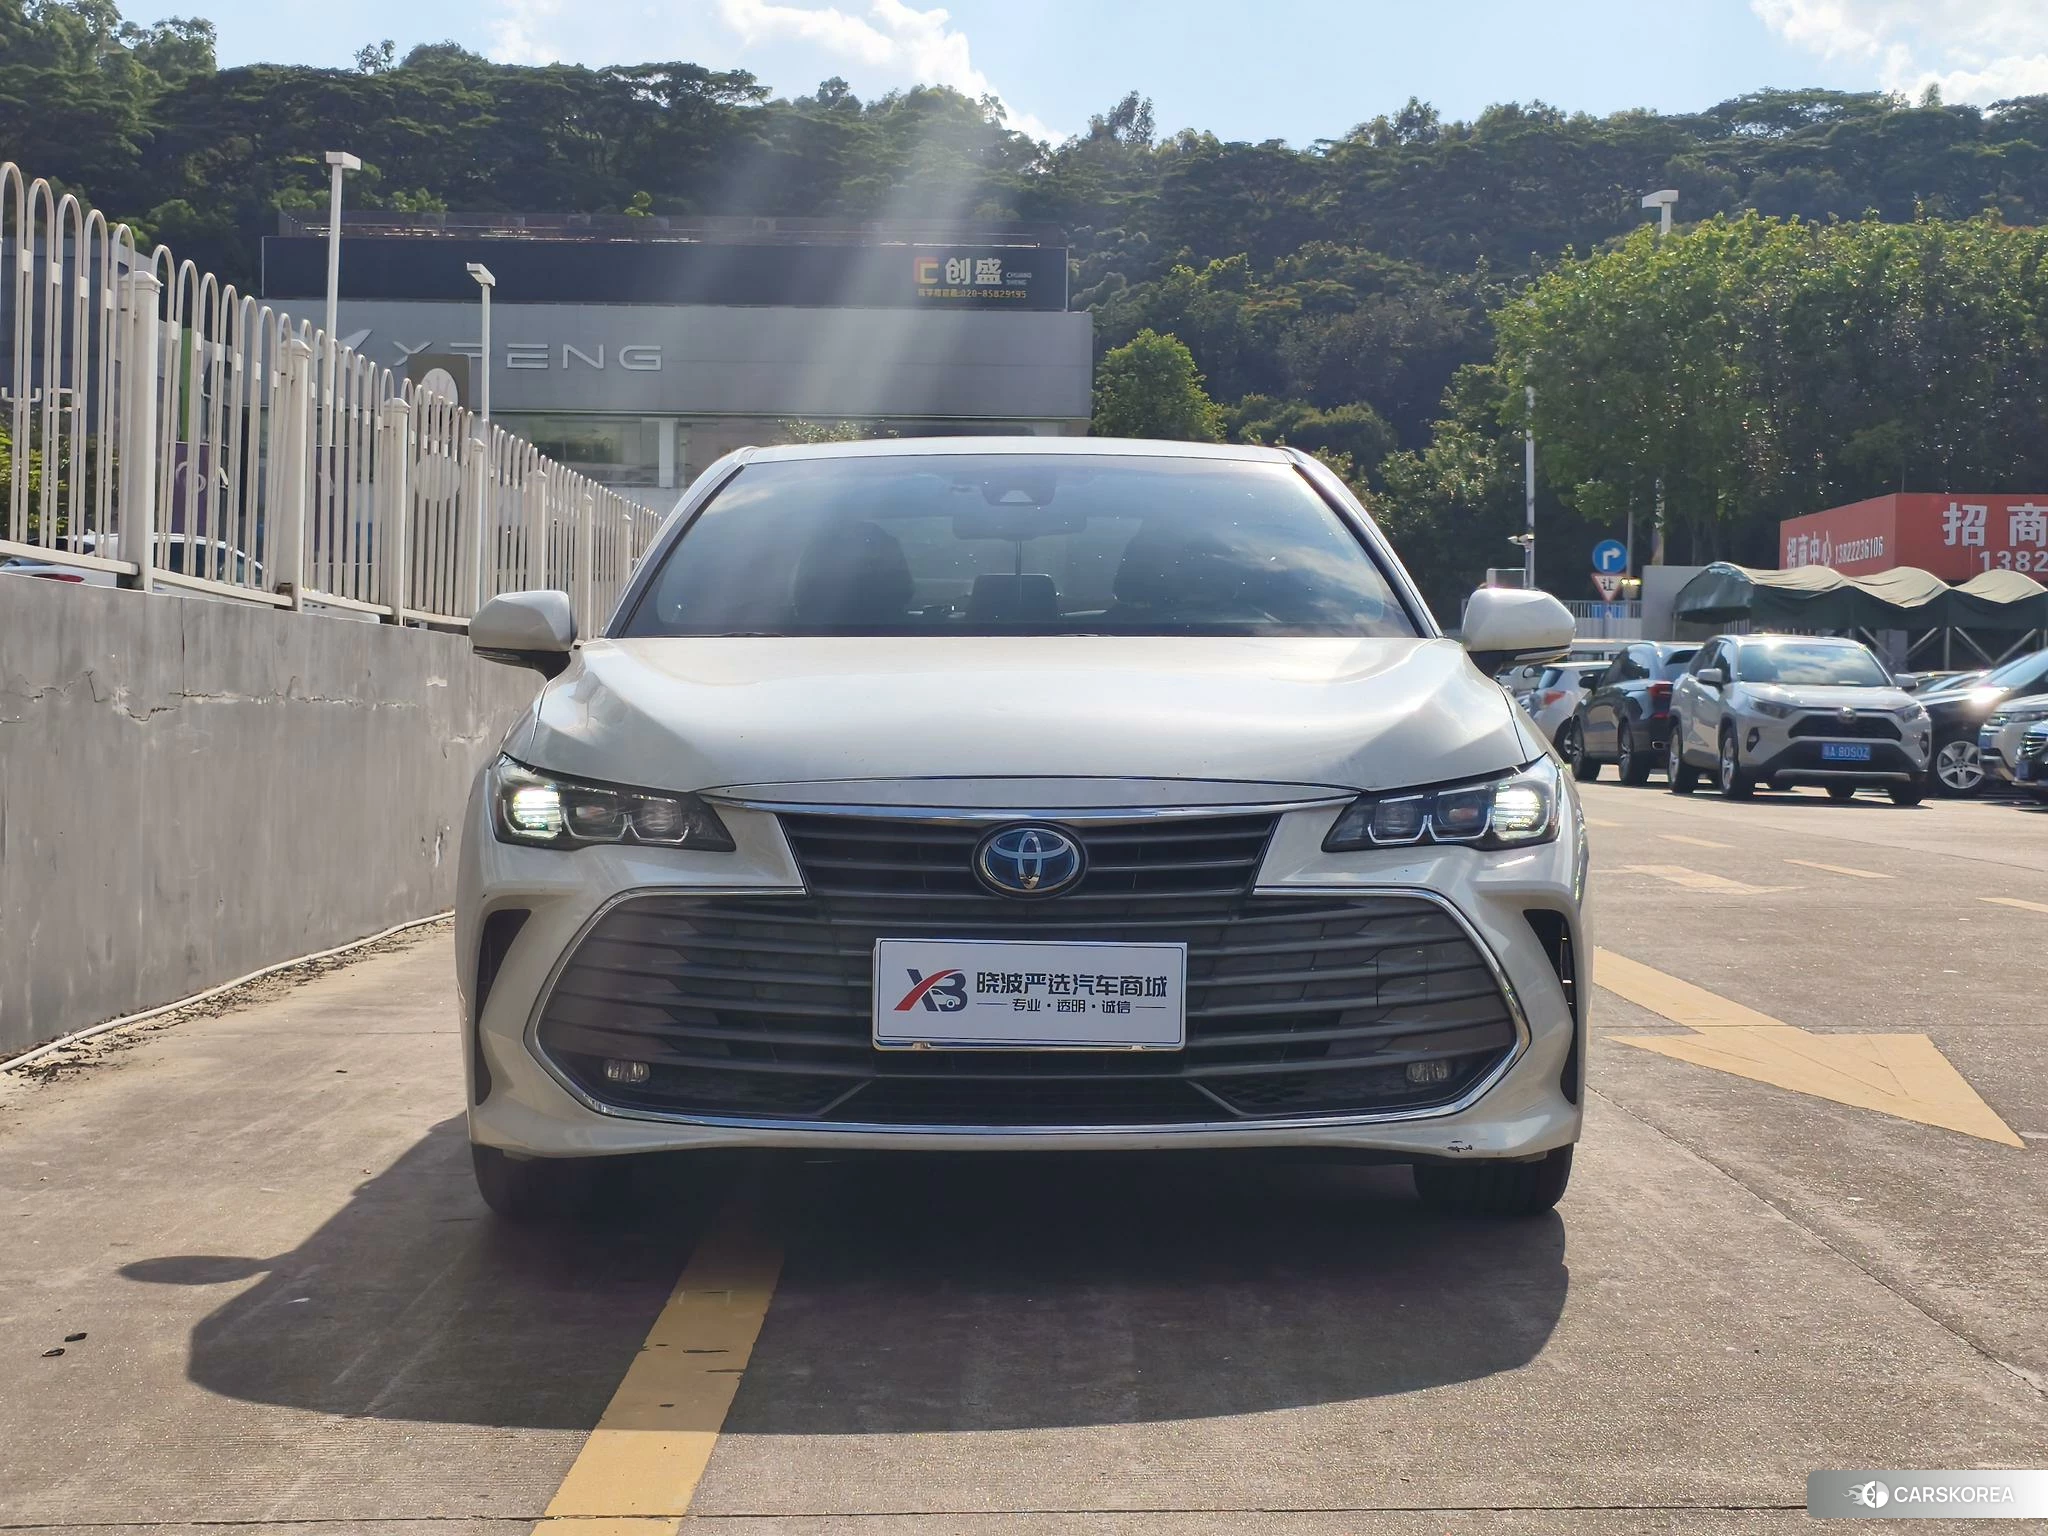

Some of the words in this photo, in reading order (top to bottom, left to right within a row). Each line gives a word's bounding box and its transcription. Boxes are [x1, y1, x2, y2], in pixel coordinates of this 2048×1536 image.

[945, 257, 1002, 285] 创盛
[1942, 502, 2048, 547] 招商
[1979, 550, 2048, 572] 1382
[976, 971, 1168, 998] 晓波严选汽车商城
